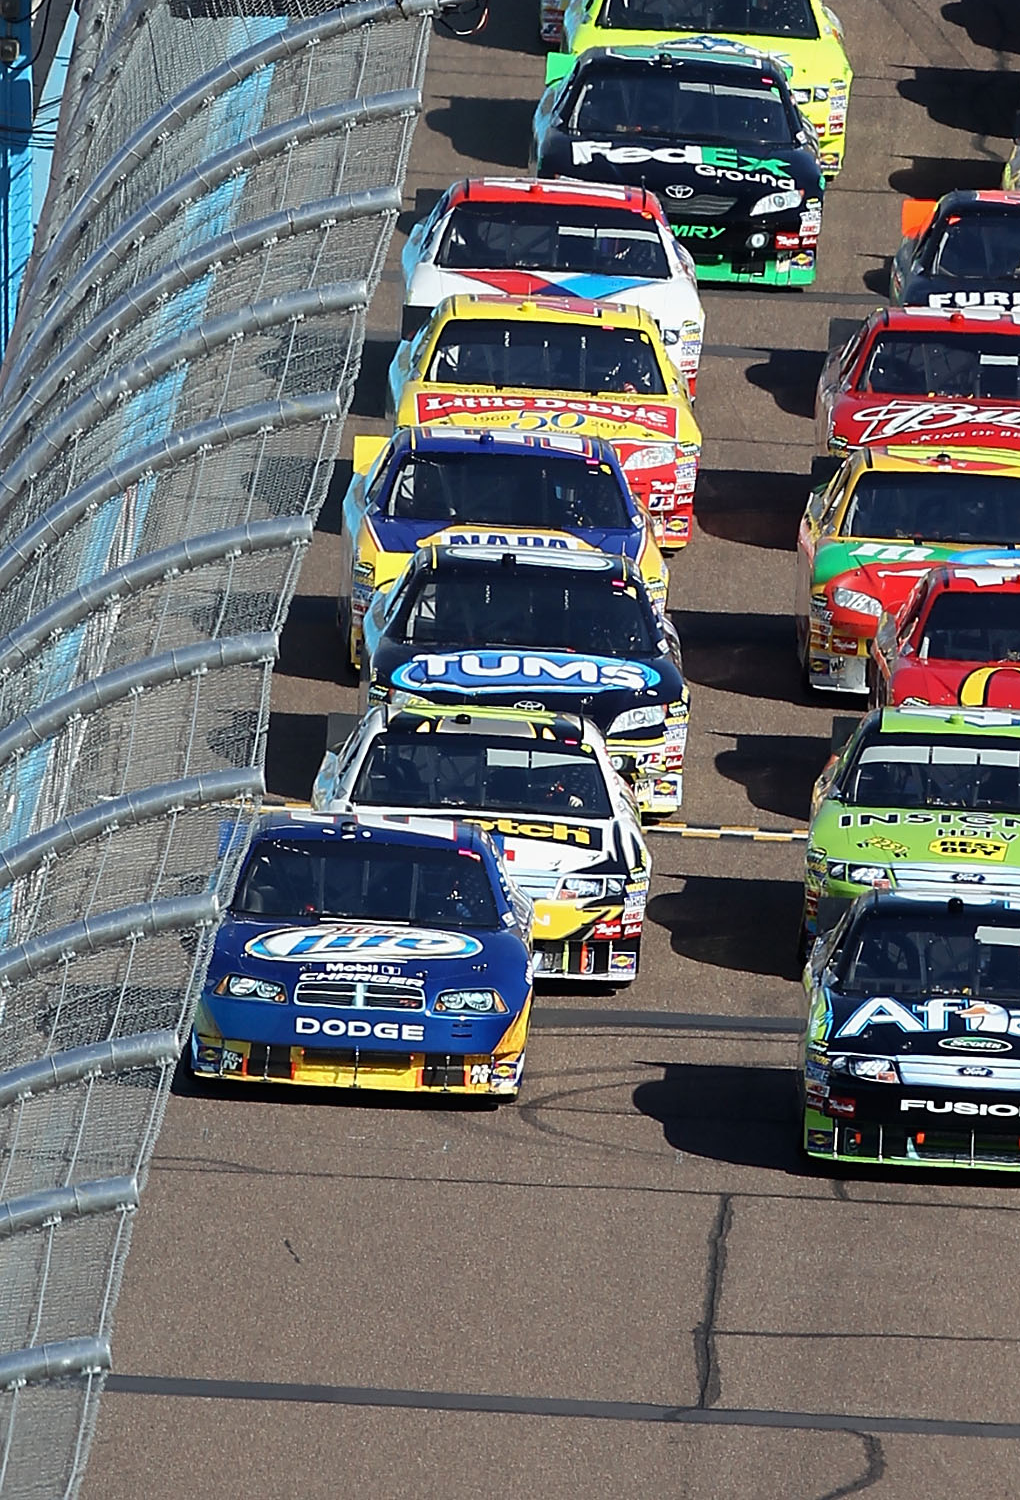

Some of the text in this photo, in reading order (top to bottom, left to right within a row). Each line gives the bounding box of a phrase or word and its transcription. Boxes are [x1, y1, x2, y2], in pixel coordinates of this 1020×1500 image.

[571, 141, 791, 179] FedEx
[694, 164, 796, 191] Ground
[670, 224, 727, 239] MRY
[425, 394, 534, 411] Little
[533, 398, 667, 422] Debbie
[473, 414, 511, 423] 1960
[511, 410, 586, 431] 50
[591, 420, 628, 431] 2010
[919, 431, 958, 441] KING
[971, 431, 995, 439] OF
[412, 653, 647, 690] TUMS
[462, 819, 592, 845] otch
[936, 827, 1019, 841] HDTV
[939, 840, 1007, 851] BEST
[940, 847, 995, 857] BUY
[955, 872, 982, 883] Ford
[325, 963, 378, 974] Mobil
[299, 971, 425, 987] CHARGER
[295, 1016, 425, 1042] DODGE
[962, 1067, 988, 1077] Ford
